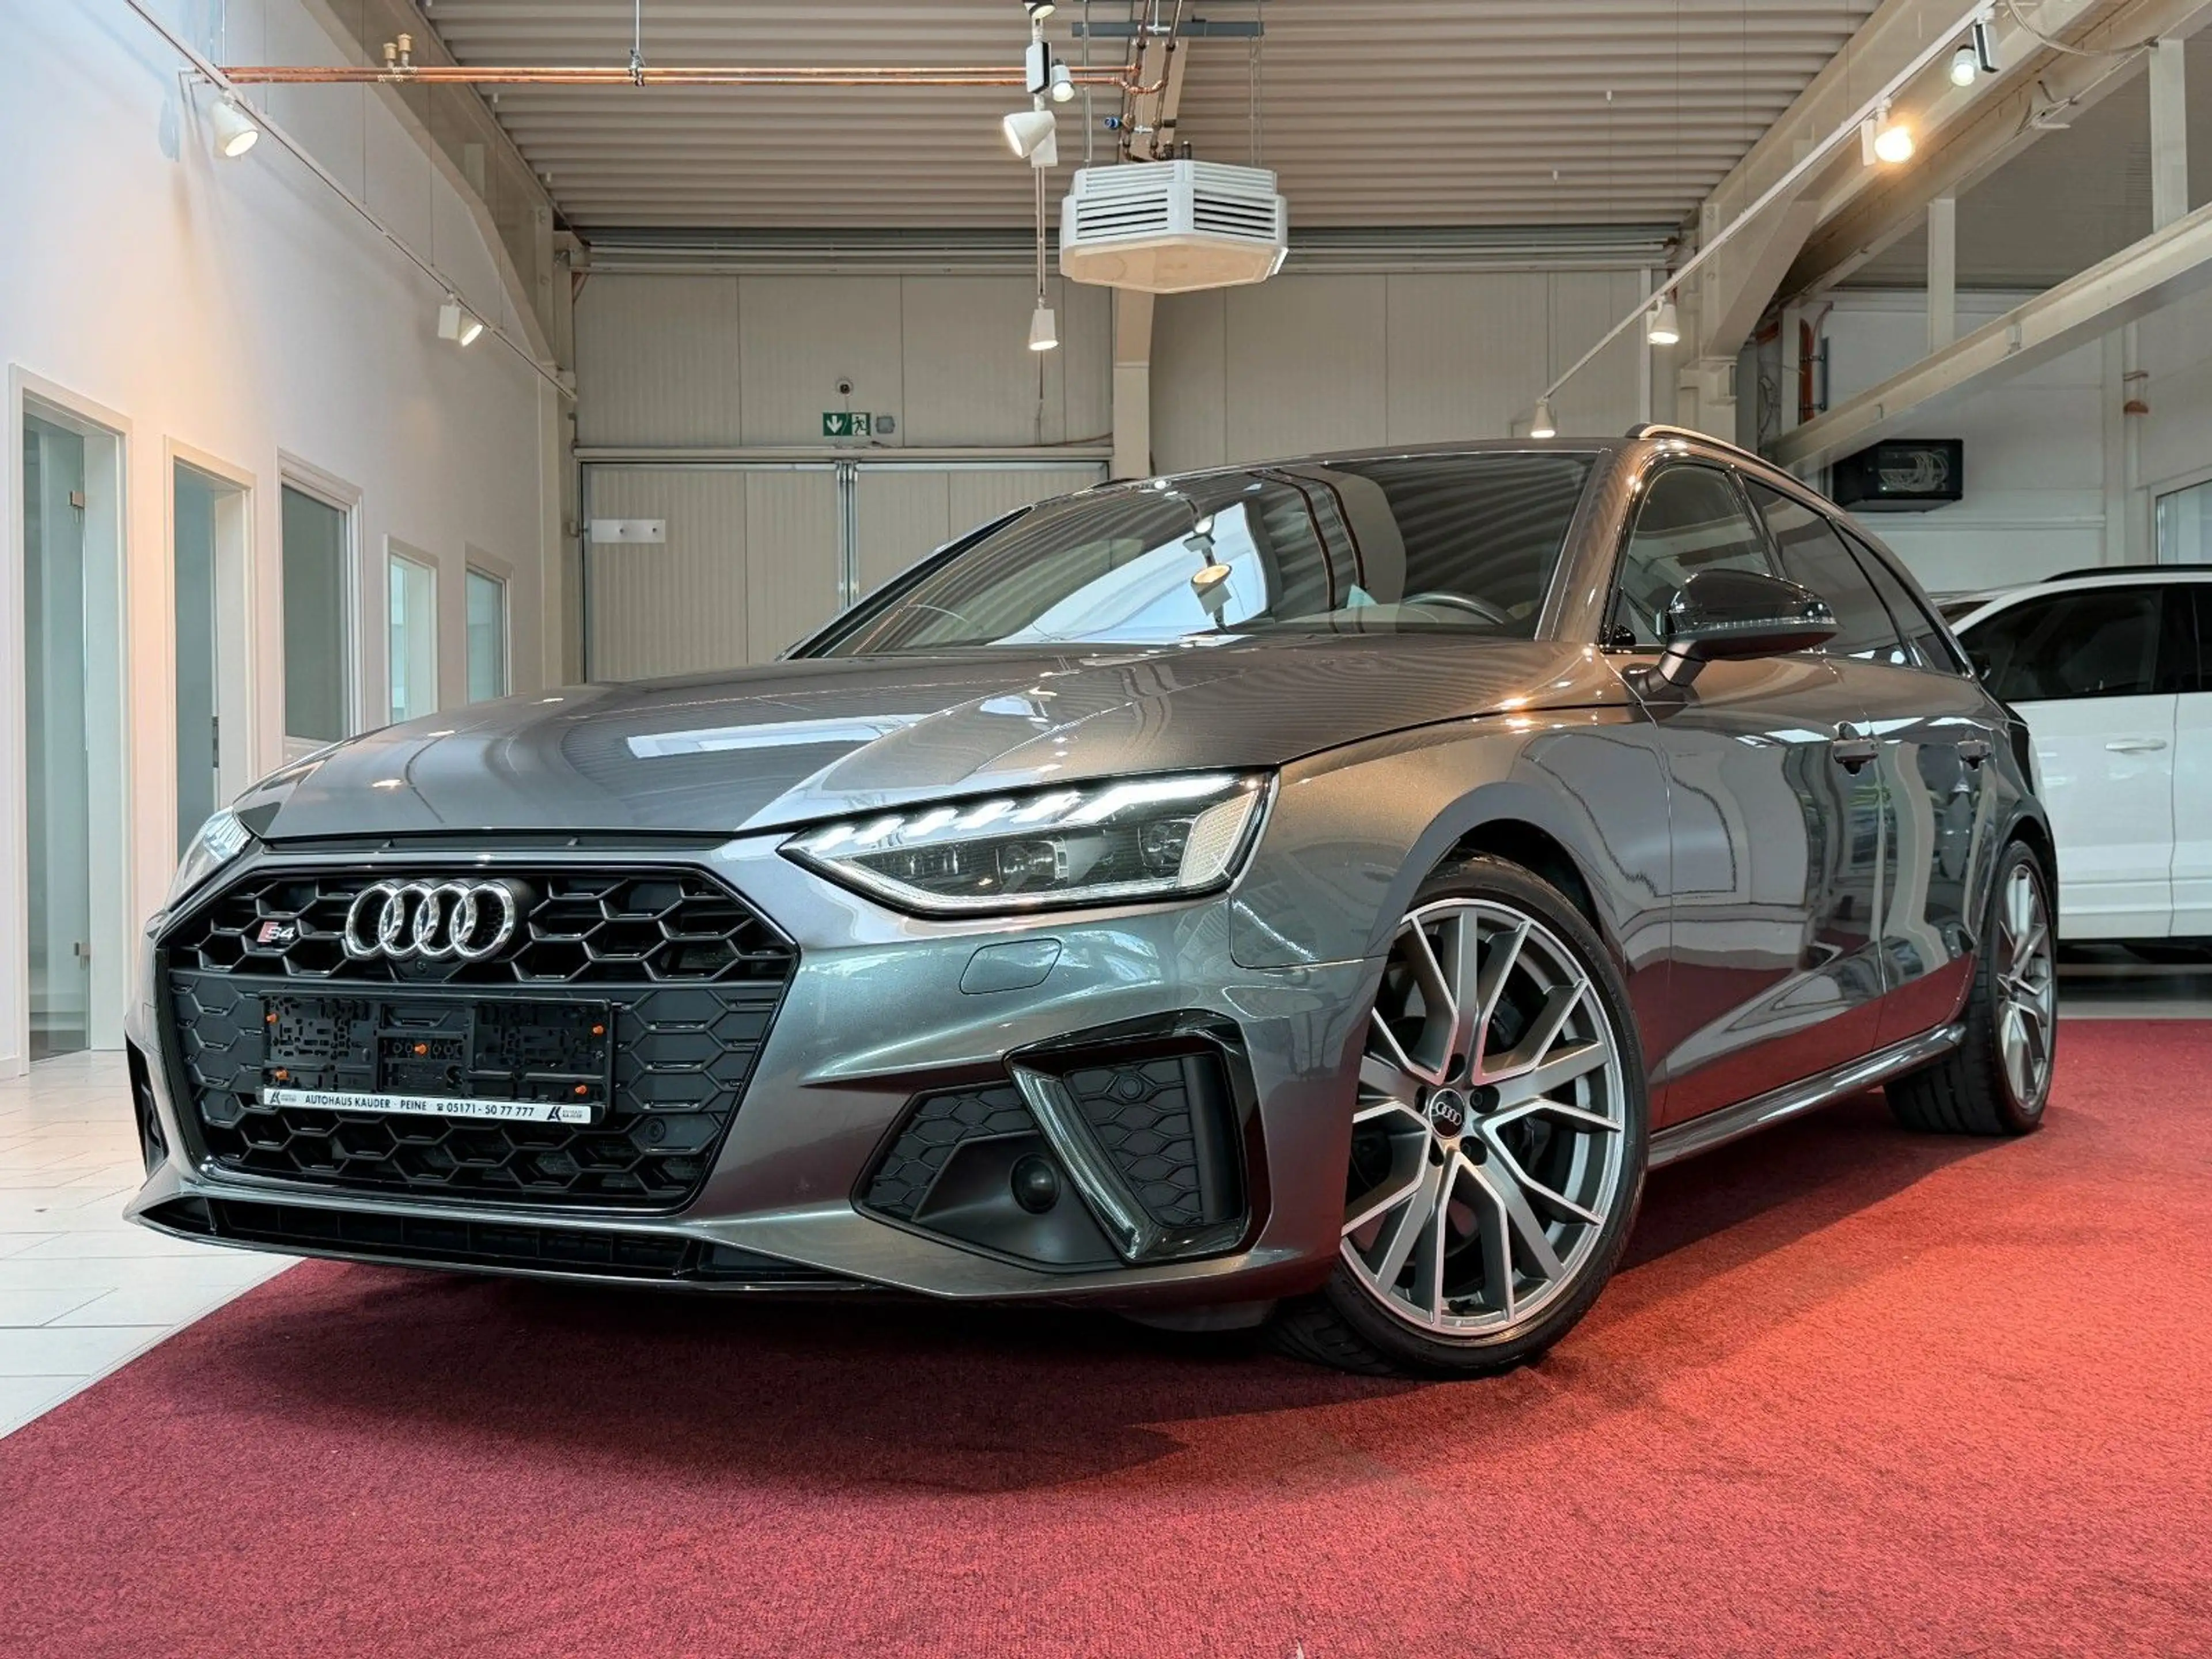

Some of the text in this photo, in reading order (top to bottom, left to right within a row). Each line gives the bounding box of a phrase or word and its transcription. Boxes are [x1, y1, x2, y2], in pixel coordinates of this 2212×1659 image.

[266, 926, 295, 941] S4
[305, 1094, 353, 1106] AUTOHAUS
[355, 1097, 391, 1108] KAUDER
[400, 1099, 427, 1111] PEINE
[446, 1101, 475, 1113] 05171
[485, 1104, 497, 1115] 50
[500, 1106, 512, 1116] 77
[516, 1106, 535, 1116] 777
